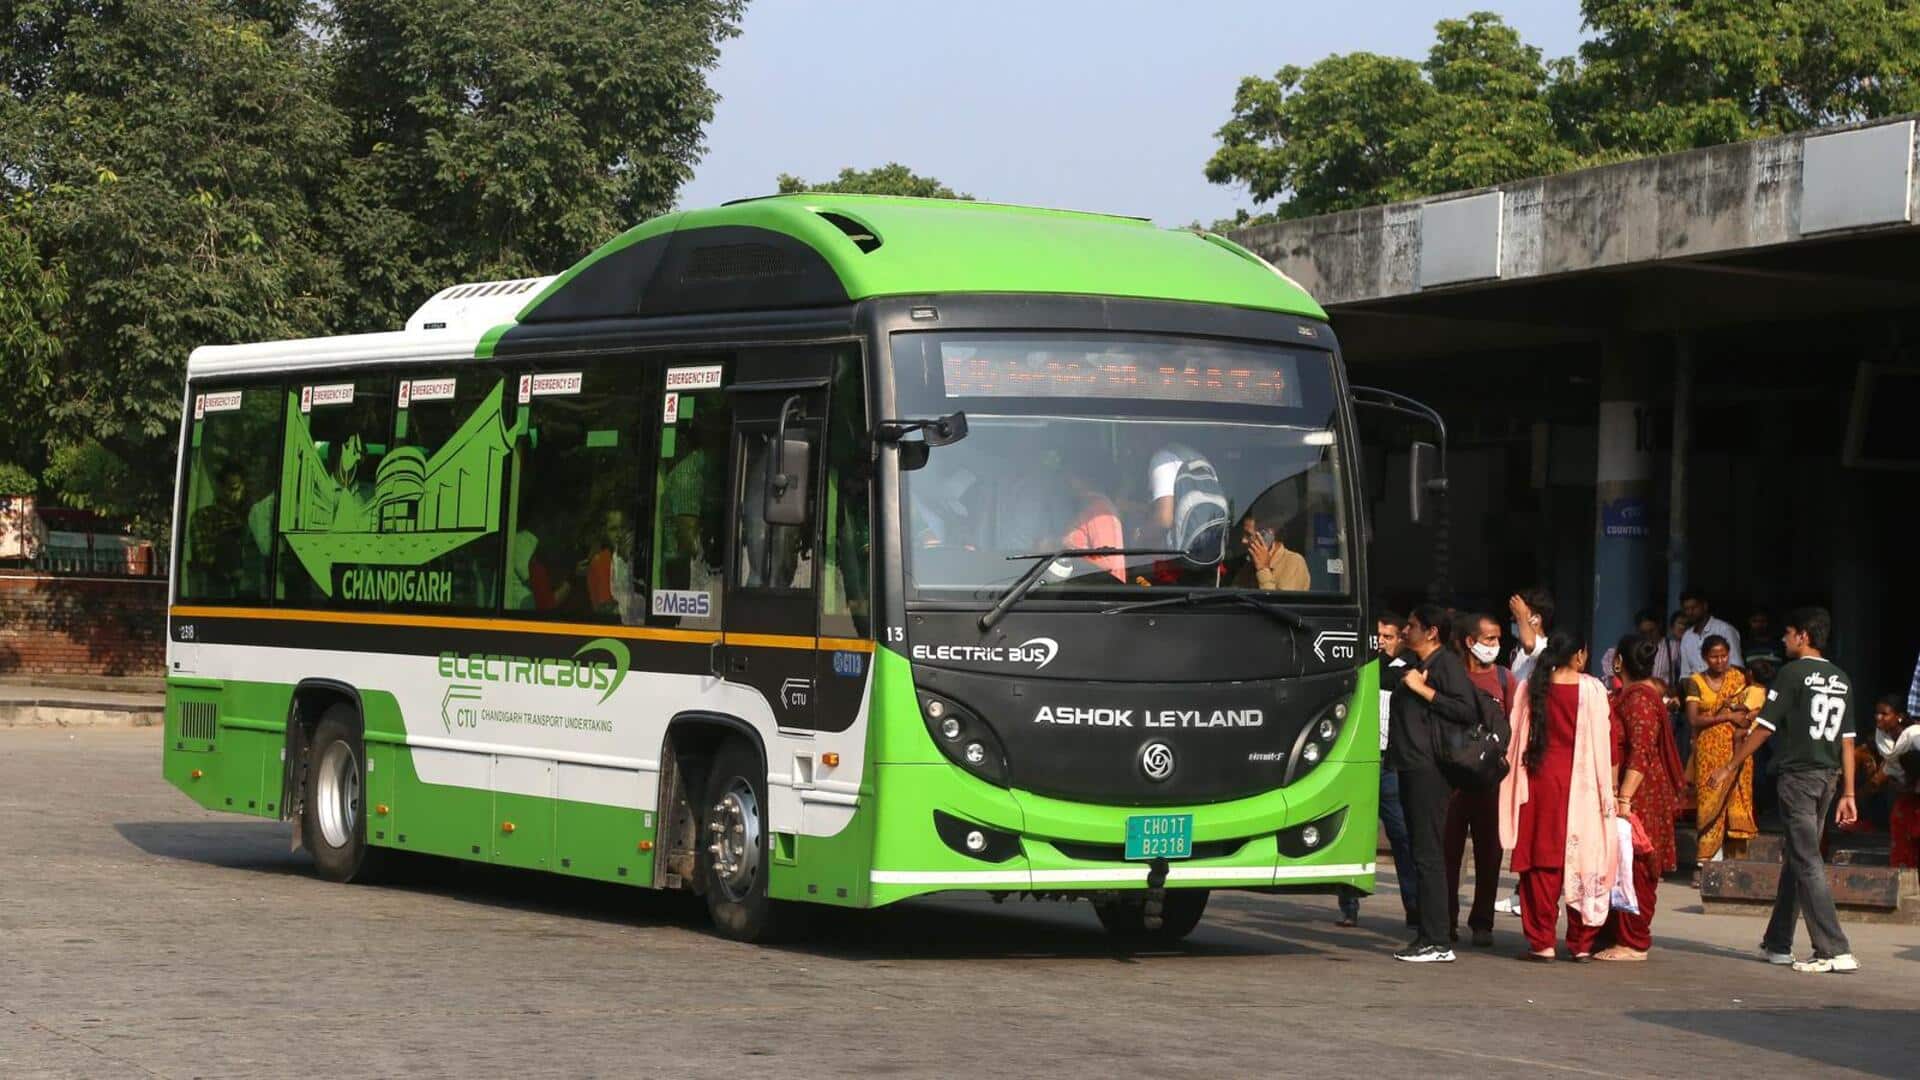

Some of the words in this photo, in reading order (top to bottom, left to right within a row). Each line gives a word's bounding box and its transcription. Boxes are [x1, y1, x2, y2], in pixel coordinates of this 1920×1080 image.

[533, 379, 566, 390] EMERGENCY
[568, 377, 580, 389] EXIT
[668, 372, 704, 384] EMERGENCY
[706, 371, 720, 383] EXIT
[313, 389, 341, 401] EMERGENCY
[342, 388, 353, 399] EXIT
[412, 384, 441, 396] EMERGENCY
[443, 383, 454, 395] EXIT
[342, 570, 452, 602] CHANDIGARH
[886, 627, 904, 642] 13
[1009, 648, 1045, 662] BUS
[1332, 646, 1354, 658] CTU
[791, 692, 806, 705] CTU
[457, 708, 477, 728] CTU
[481, 709, 523, 724] CHANDIGARH
[524, 713, 563, 727] TRANSPORT
[564, 717, 613, 732] UNDERTAKING
[1034, 706, 1134, 727] ASHOK
[1146, 710, 1263, 728] LEYLAND
[1809, 693, 1846, 742] 93
[1144, 817, 1185, 834] CH01T
[1143, 838, 1185, 855] B2318
